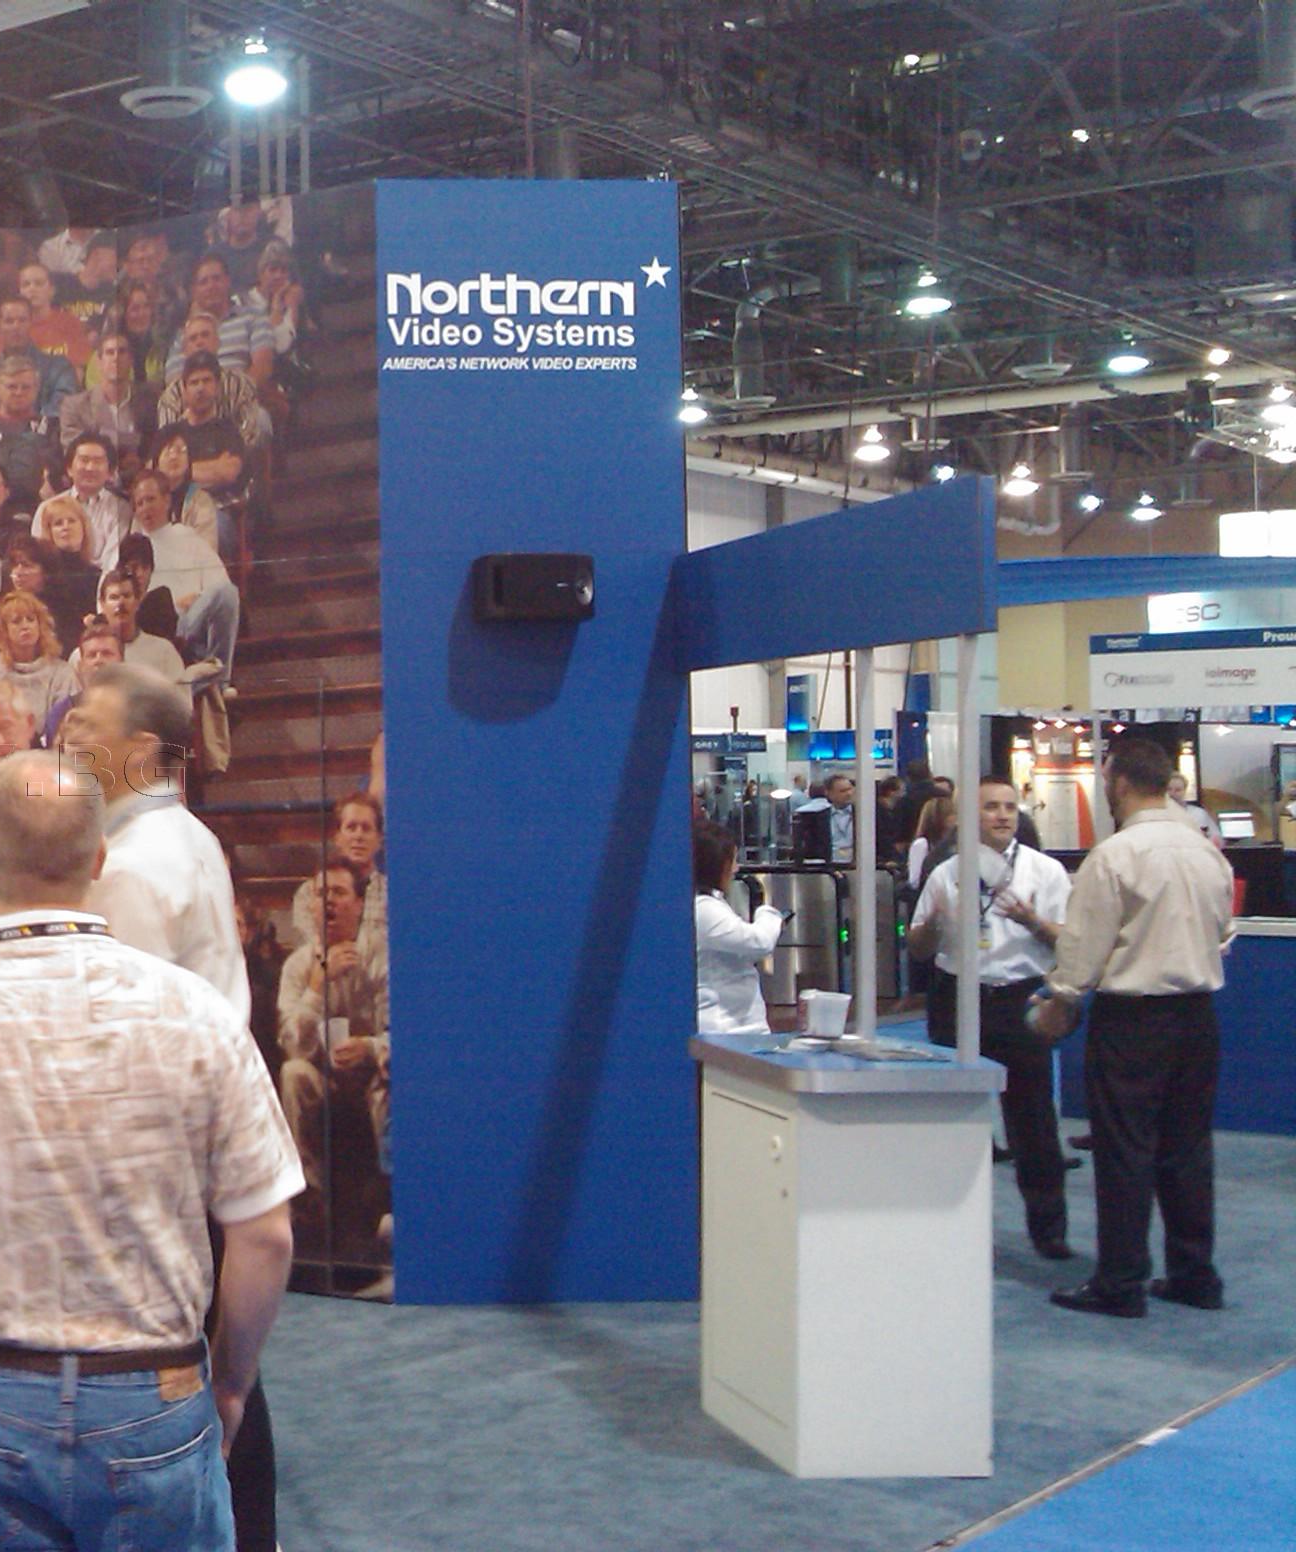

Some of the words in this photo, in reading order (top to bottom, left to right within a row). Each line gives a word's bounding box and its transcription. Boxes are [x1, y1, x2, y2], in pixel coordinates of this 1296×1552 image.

[386, 272, 635, 316] Northern
[387, 317, 483, 347] Video
[493, 317, 635, 353] Systems
[382, 357, 457, 371] AMERICA'S
[459, 357, 529, 371] NETWORK
[531, 357, 573, 371] VIDEO
[575, 357, 637, 371] EXPERTS
